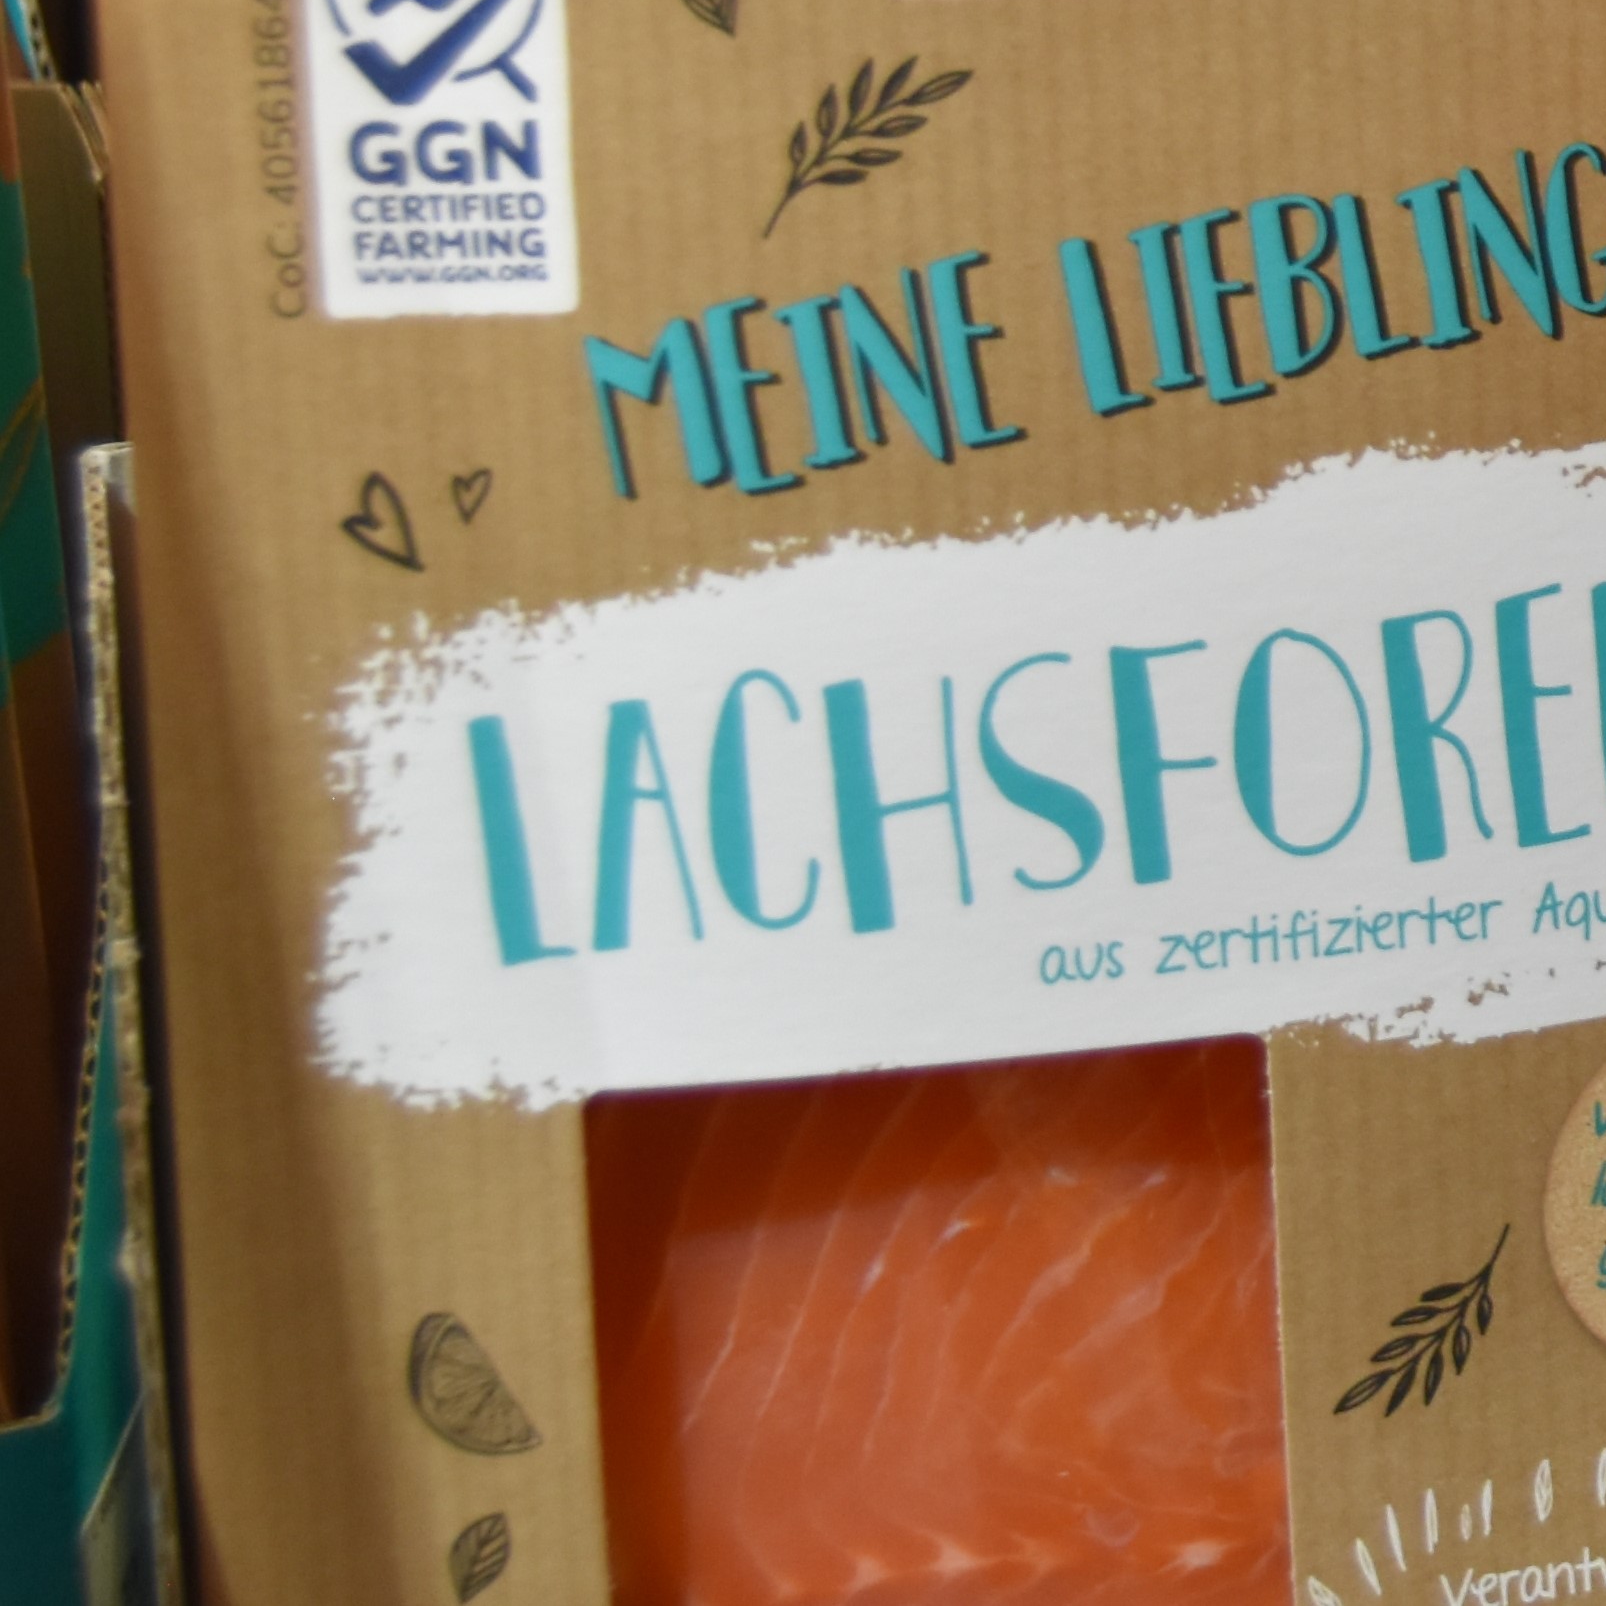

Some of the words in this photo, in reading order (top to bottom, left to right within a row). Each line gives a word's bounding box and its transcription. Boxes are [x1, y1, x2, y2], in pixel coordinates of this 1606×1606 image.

[349, 119, 541, 186] GGN
[351, 194, 546, 224] CERTIFIED
[354, 229, 547, 260] FARMING
[583, 250, 1028, 499] MEINE
[1039, 937, 1125, 985] aus
[1156, 895, 1504, 976] zertifizierter
